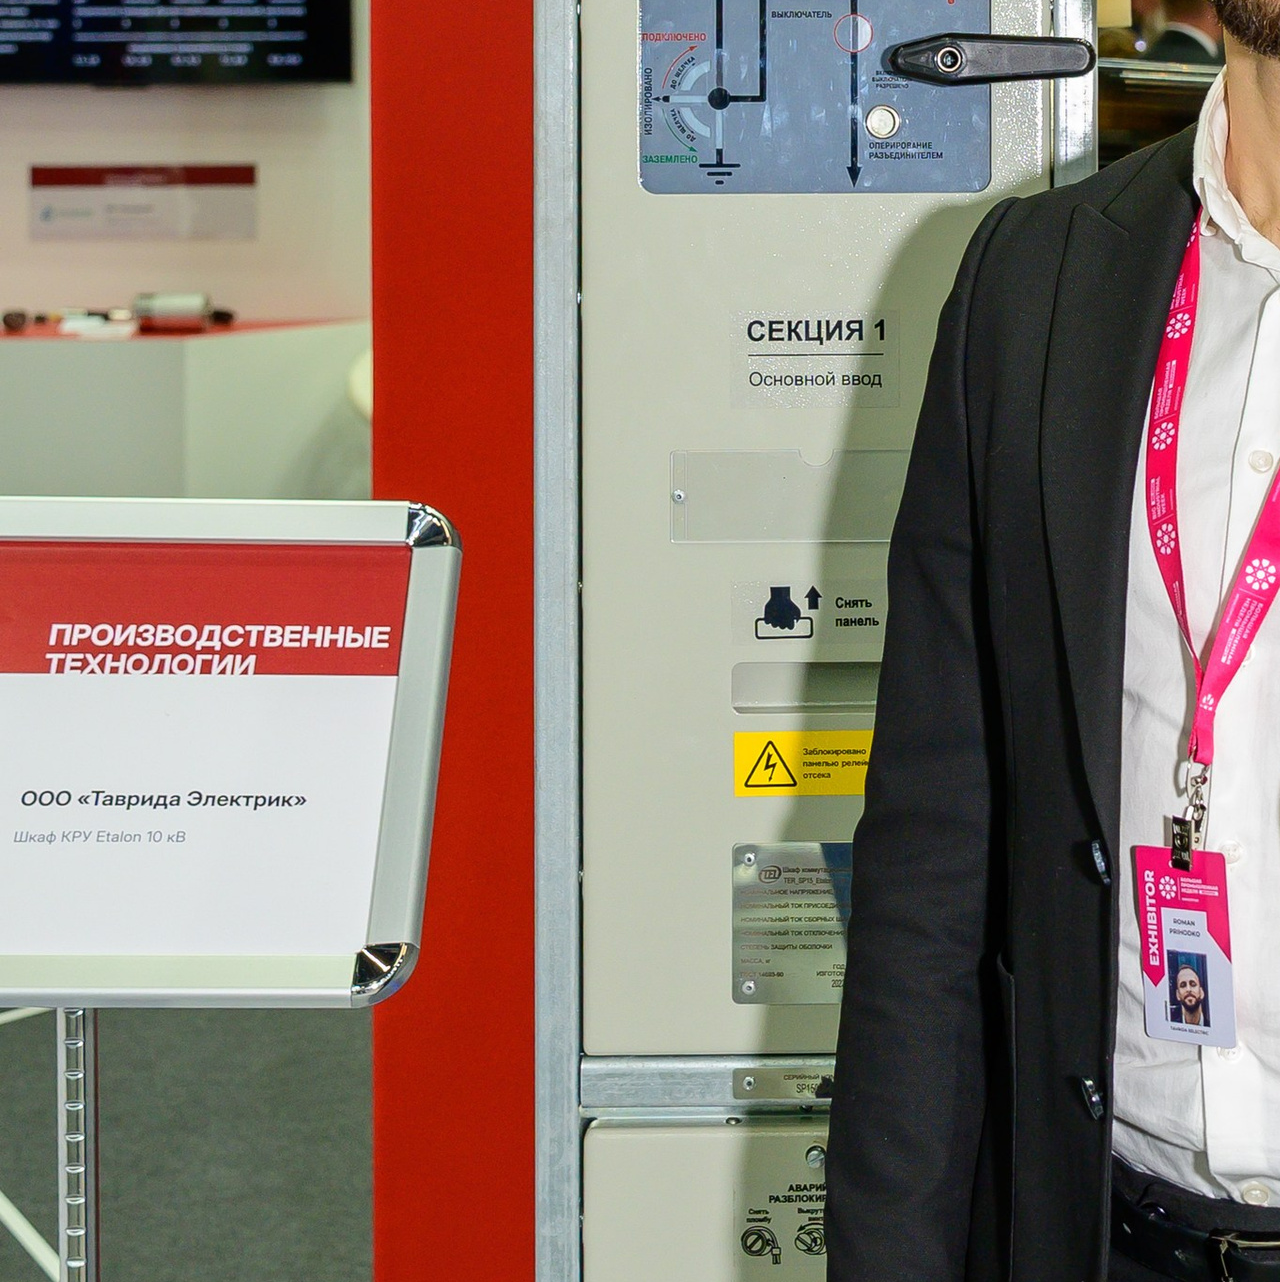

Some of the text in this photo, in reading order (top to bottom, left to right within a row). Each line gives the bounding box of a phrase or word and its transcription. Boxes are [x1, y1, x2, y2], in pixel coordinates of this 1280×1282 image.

[772, 10, 832, 19] ВЫКЛЮЧАТЕЛЬ
[642, 33, 706, 42] ПОДКЛЮЧЕНО
[644, 67, 652, 135] ИЗОЛИРОВАНО
[642, 155, 698, 163] ЗАЗЕМЛЕНО
[747, 319, 886, 344] СЕКЦИЯ 1
[749, 372, 882, 389] Основной ввод
[835, 597, 872, 609] Снять
[835, 616, 879, 627] панель
[1235, 598, 1251, 628] НЕДЕЛЯ
[1242, 603, 1263, 639] БОЛЬШАЯ
[48, 624, 391, 651] ПРОИЗВОДСТВЕННЫЕ
[1226, 600, 1257, 665] ПРОМЫШЛЕННАЯ
[46, 653, 256, 676] ТЕХНОЛОГИИ
[803, 748, 866, 756] Заблокировано
[20, 790, 308, 812] ООО «Таврида Электрик»
[14, 830, 186, 845] Шкаф КРУ Etalon 10 кВ
[1144, 871, 1160, 966] EXHIBITOR
[1173, 918, 1195, 926] ROMAN
[1169, 928, 1200, 937] PRIHODKO
